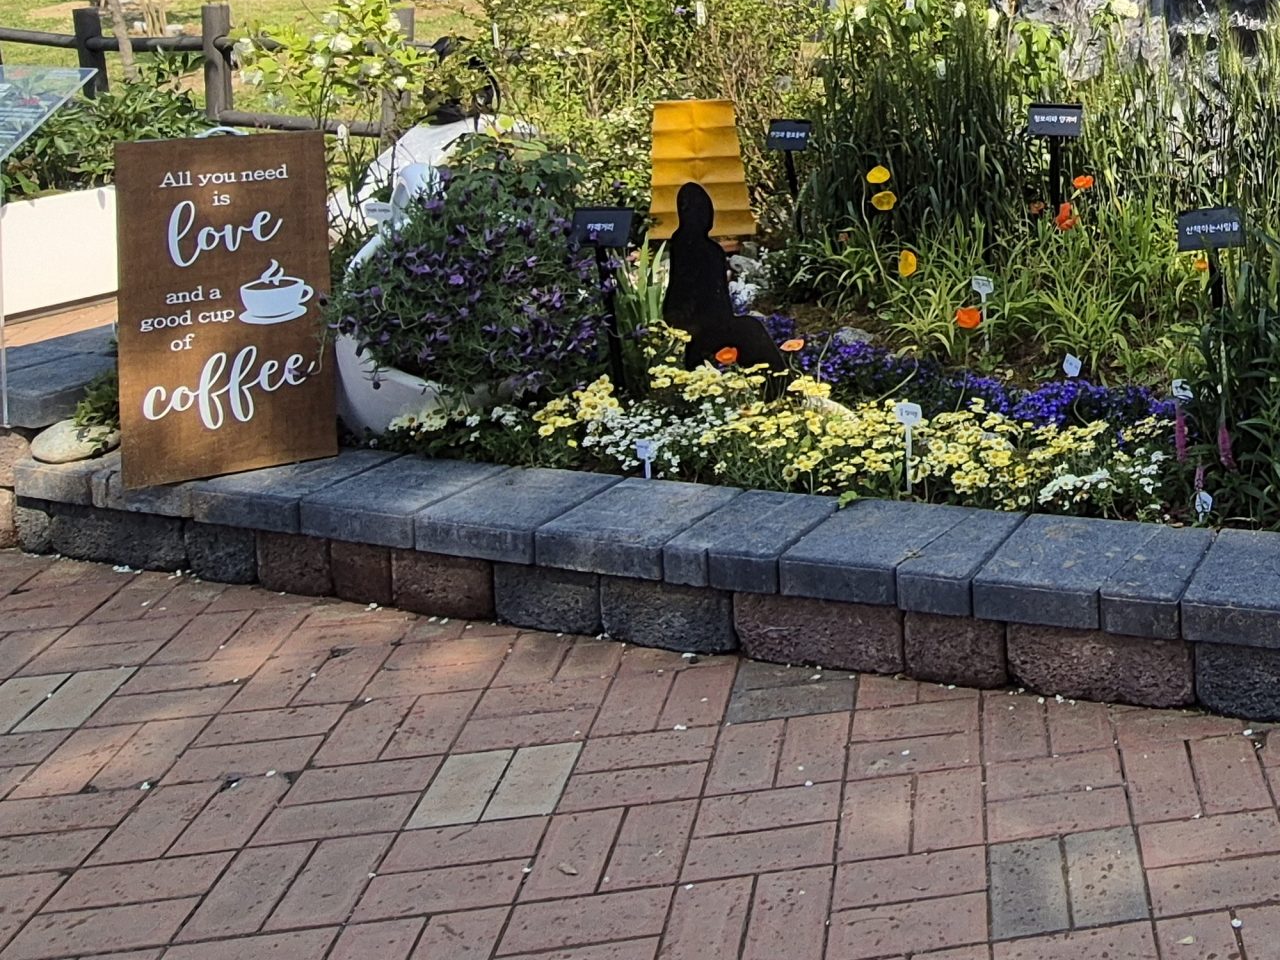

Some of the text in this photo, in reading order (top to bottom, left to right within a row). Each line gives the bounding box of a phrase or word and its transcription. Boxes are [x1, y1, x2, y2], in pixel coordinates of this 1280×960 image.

[159, 164, 289, 188] All you need
[212, 190, 231, 206] is
[167, 200, 283, 268] love
[165, 286, 222, 305] and a
[139, 309, 236, 332] good cup
[170, 334, 195, 352] of
[142, 345, 316, 430] coffee
